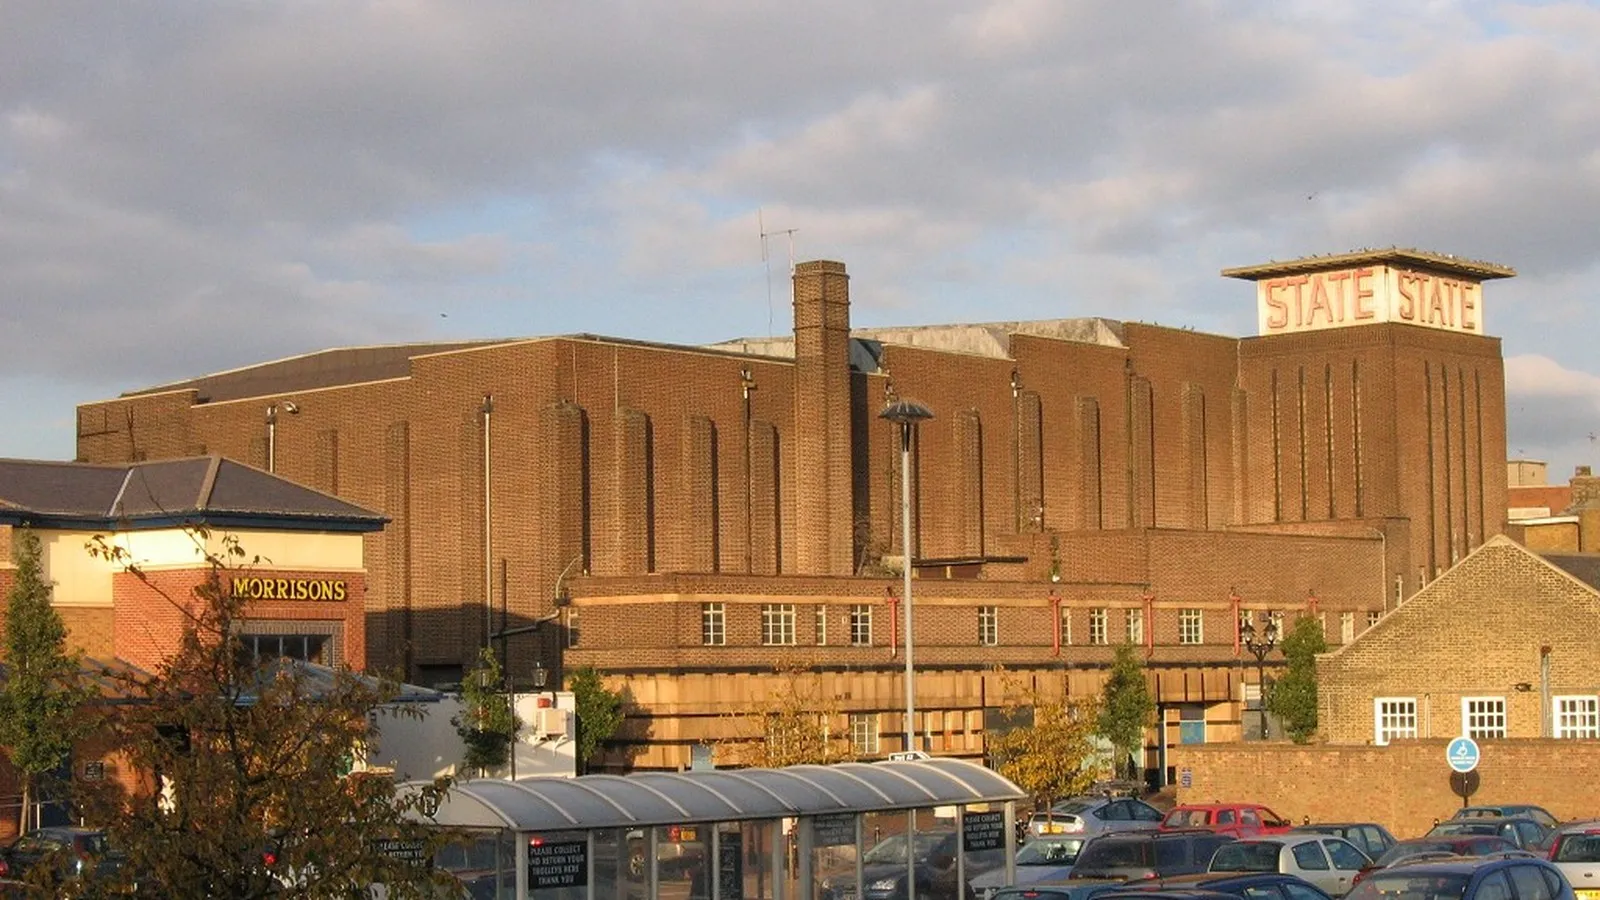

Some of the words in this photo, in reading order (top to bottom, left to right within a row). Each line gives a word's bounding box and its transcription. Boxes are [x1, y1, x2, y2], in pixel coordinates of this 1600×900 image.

[1265, 269, 1374, 329] STATE
[1397, 269, 1475, 330] STATE
[233, 578, 345, 600] MORRISONS
[530, 846, 553, 856] PLEASE
[554, 844, 581, 855] COLLECT
[542, 855, 567, 865] RETURN
[567, 854, 585, 864] YOUR
[564, 864, 580, 873] HERE
[538, 875, 560, 885] THANK
[561, 874, 575, 884] YOU
